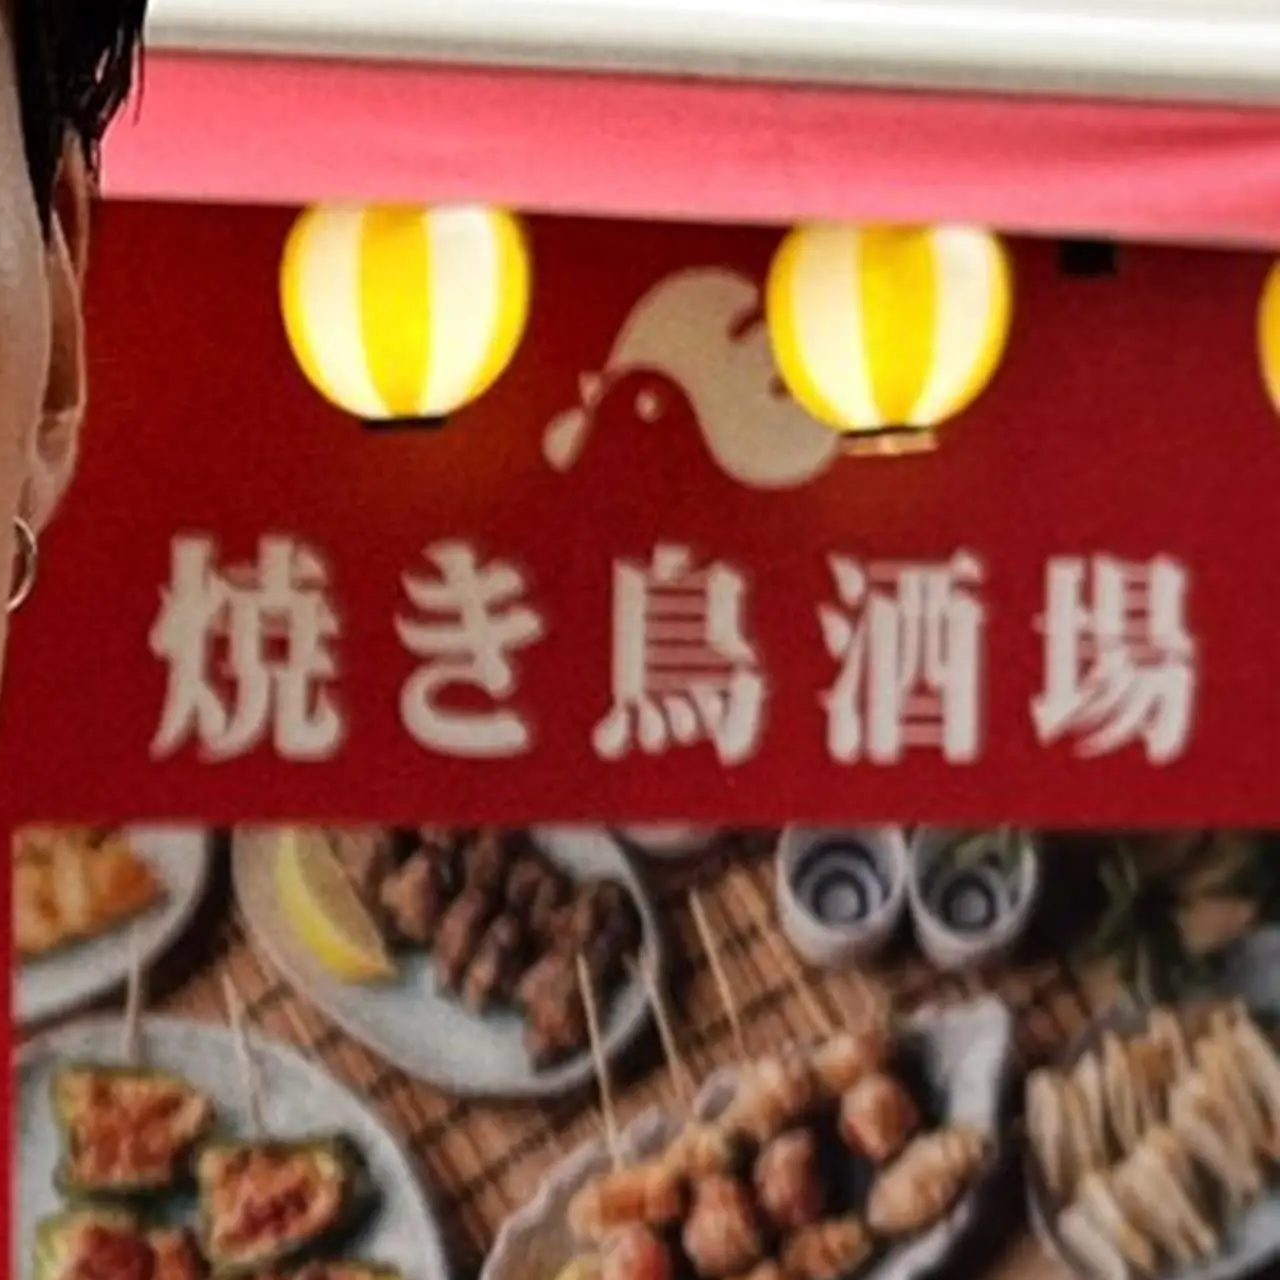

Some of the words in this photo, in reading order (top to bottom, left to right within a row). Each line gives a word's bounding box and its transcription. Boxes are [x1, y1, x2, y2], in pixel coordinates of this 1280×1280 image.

[148, 534, 1200, 767] 焼き鳥酒場
